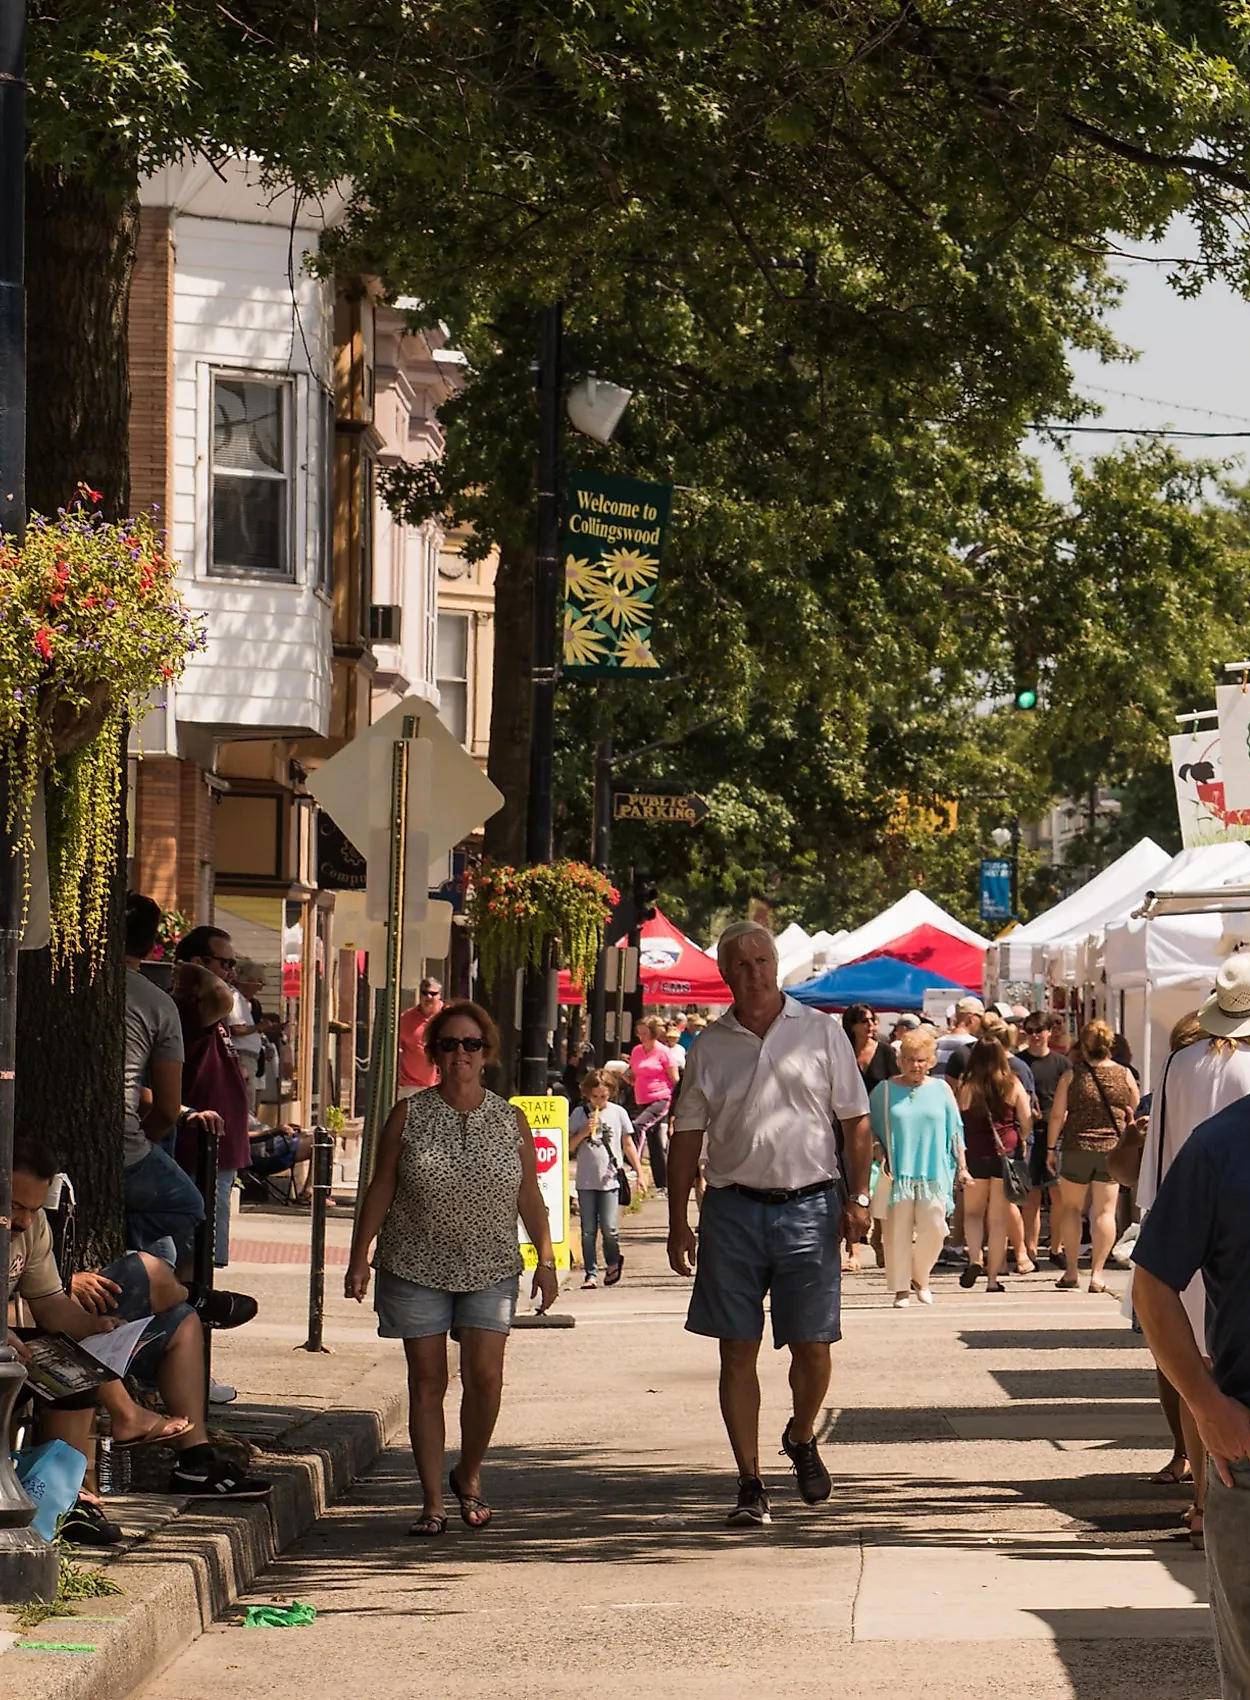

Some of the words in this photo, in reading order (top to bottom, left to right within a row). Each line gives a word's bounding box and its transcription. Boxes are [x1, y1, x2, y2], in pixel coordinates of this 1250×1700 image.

[577, 489, 640, 519] Welcome
[643, 502, 658, 521] to
[568, 513, 661, 545] Collingswood
[628, 794, 689, 808] PUBLIC
[620, 804, 696, 819] PARKING
[520, 1101, 556, 1112] STATE
[533, 1115, 550, 1125] AW
